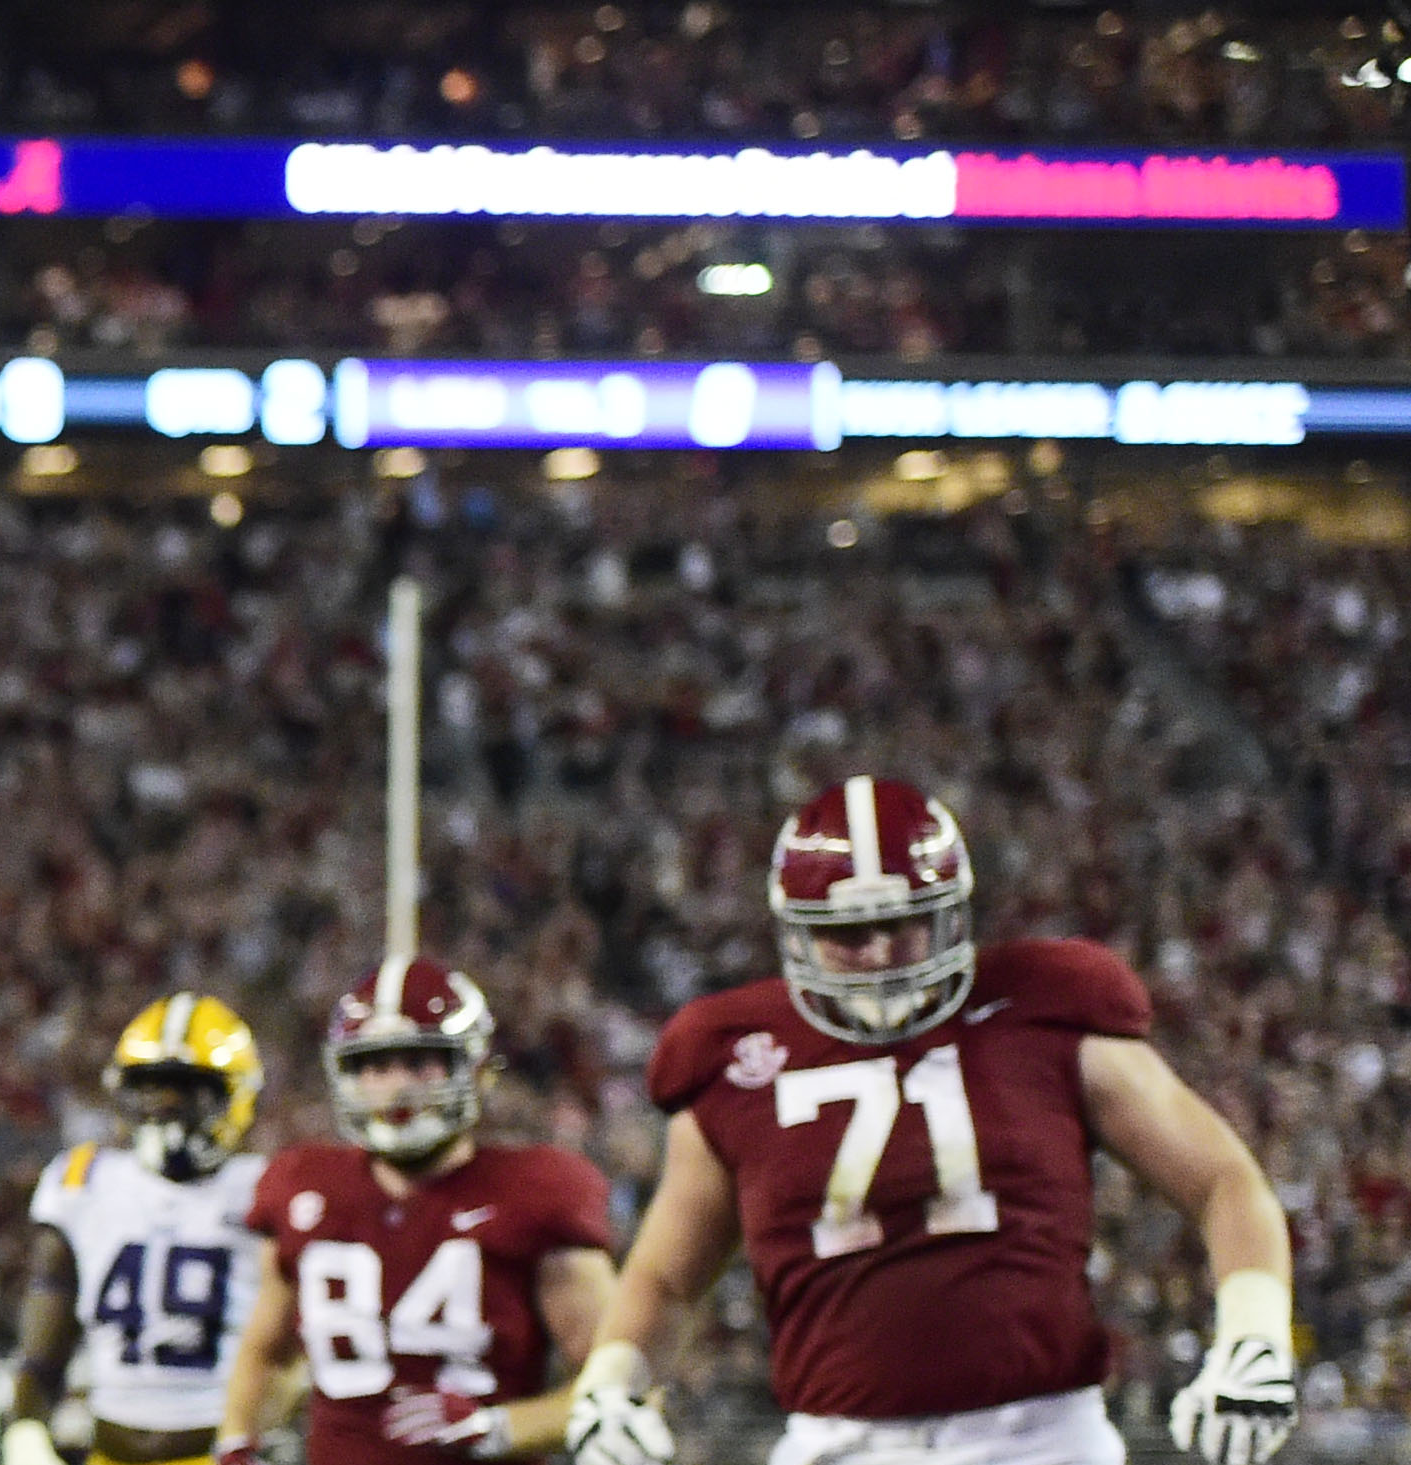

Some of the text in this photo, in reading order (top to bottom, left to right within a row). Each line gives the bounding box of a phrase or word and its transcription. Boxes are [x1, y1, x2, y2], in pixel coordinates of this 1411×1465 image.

[775, 1043, 999, 1259] 71
[96, 1243, 231, 1369] 49
[298, 1238, 498, 1399] 84
